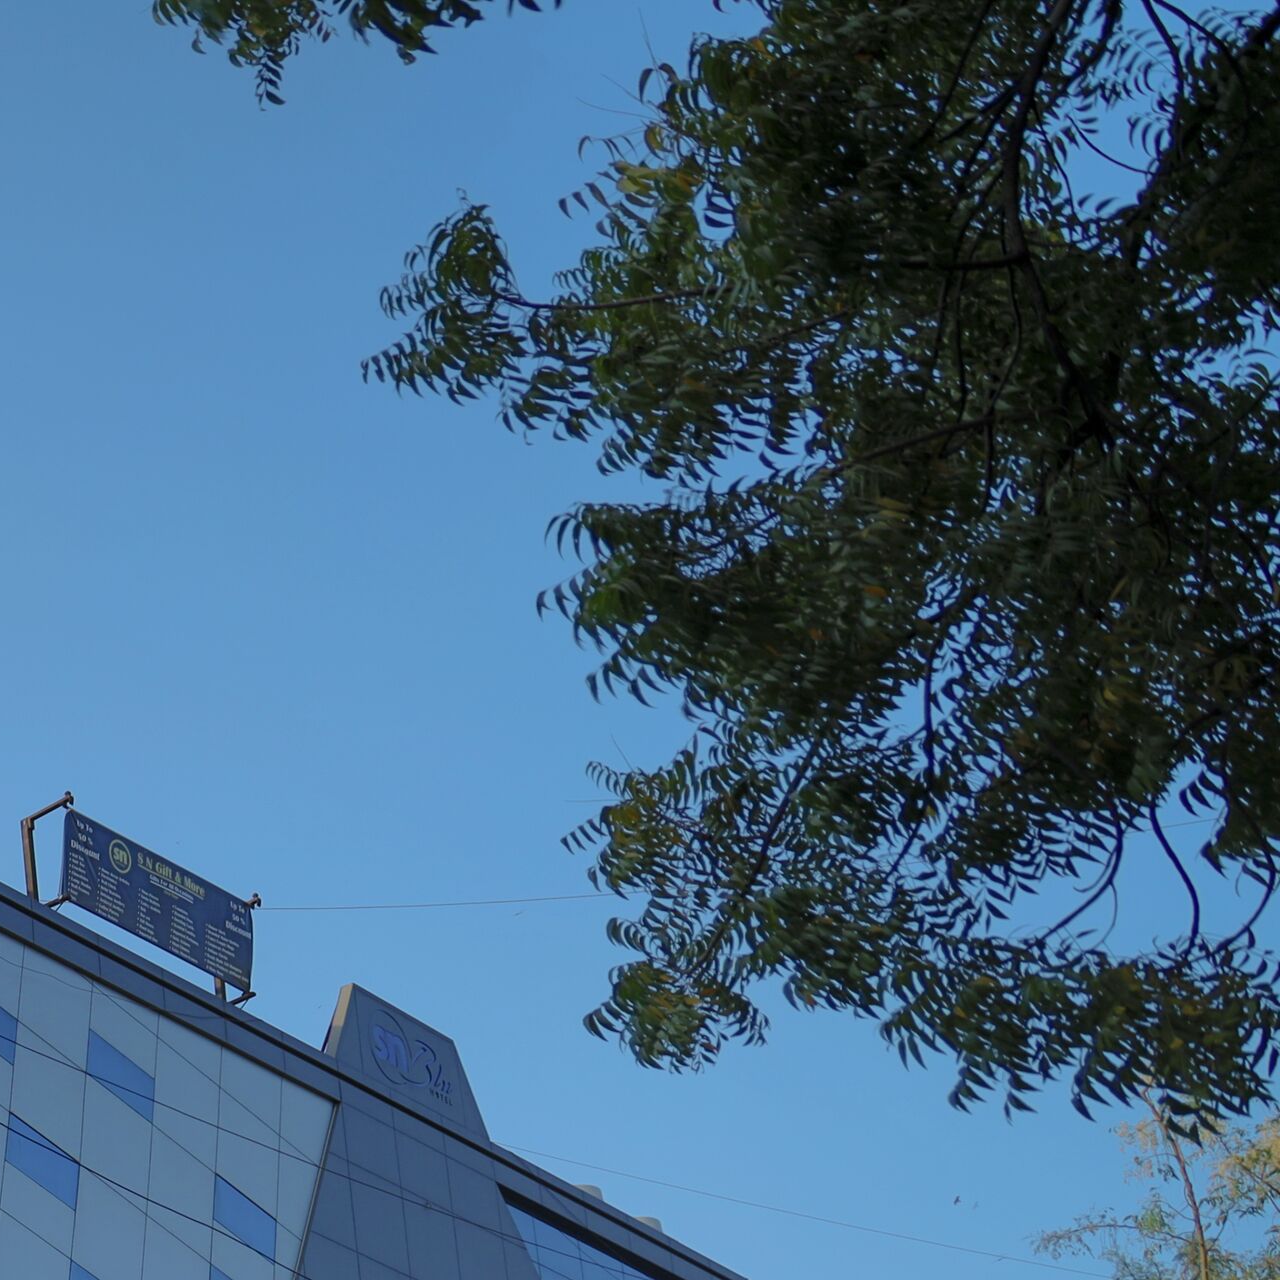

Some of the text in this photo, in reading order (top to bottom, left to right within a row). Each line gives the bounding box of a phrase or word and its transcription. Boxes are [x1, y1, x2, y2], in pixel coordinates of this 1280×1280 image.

[71, 840, 100, 861] Discount
[112, 847, 127, 864] sn
[156, 862, 172, 878] Gift
[175, 871, 181, 884] &
[184, 876, 205, 897] More
